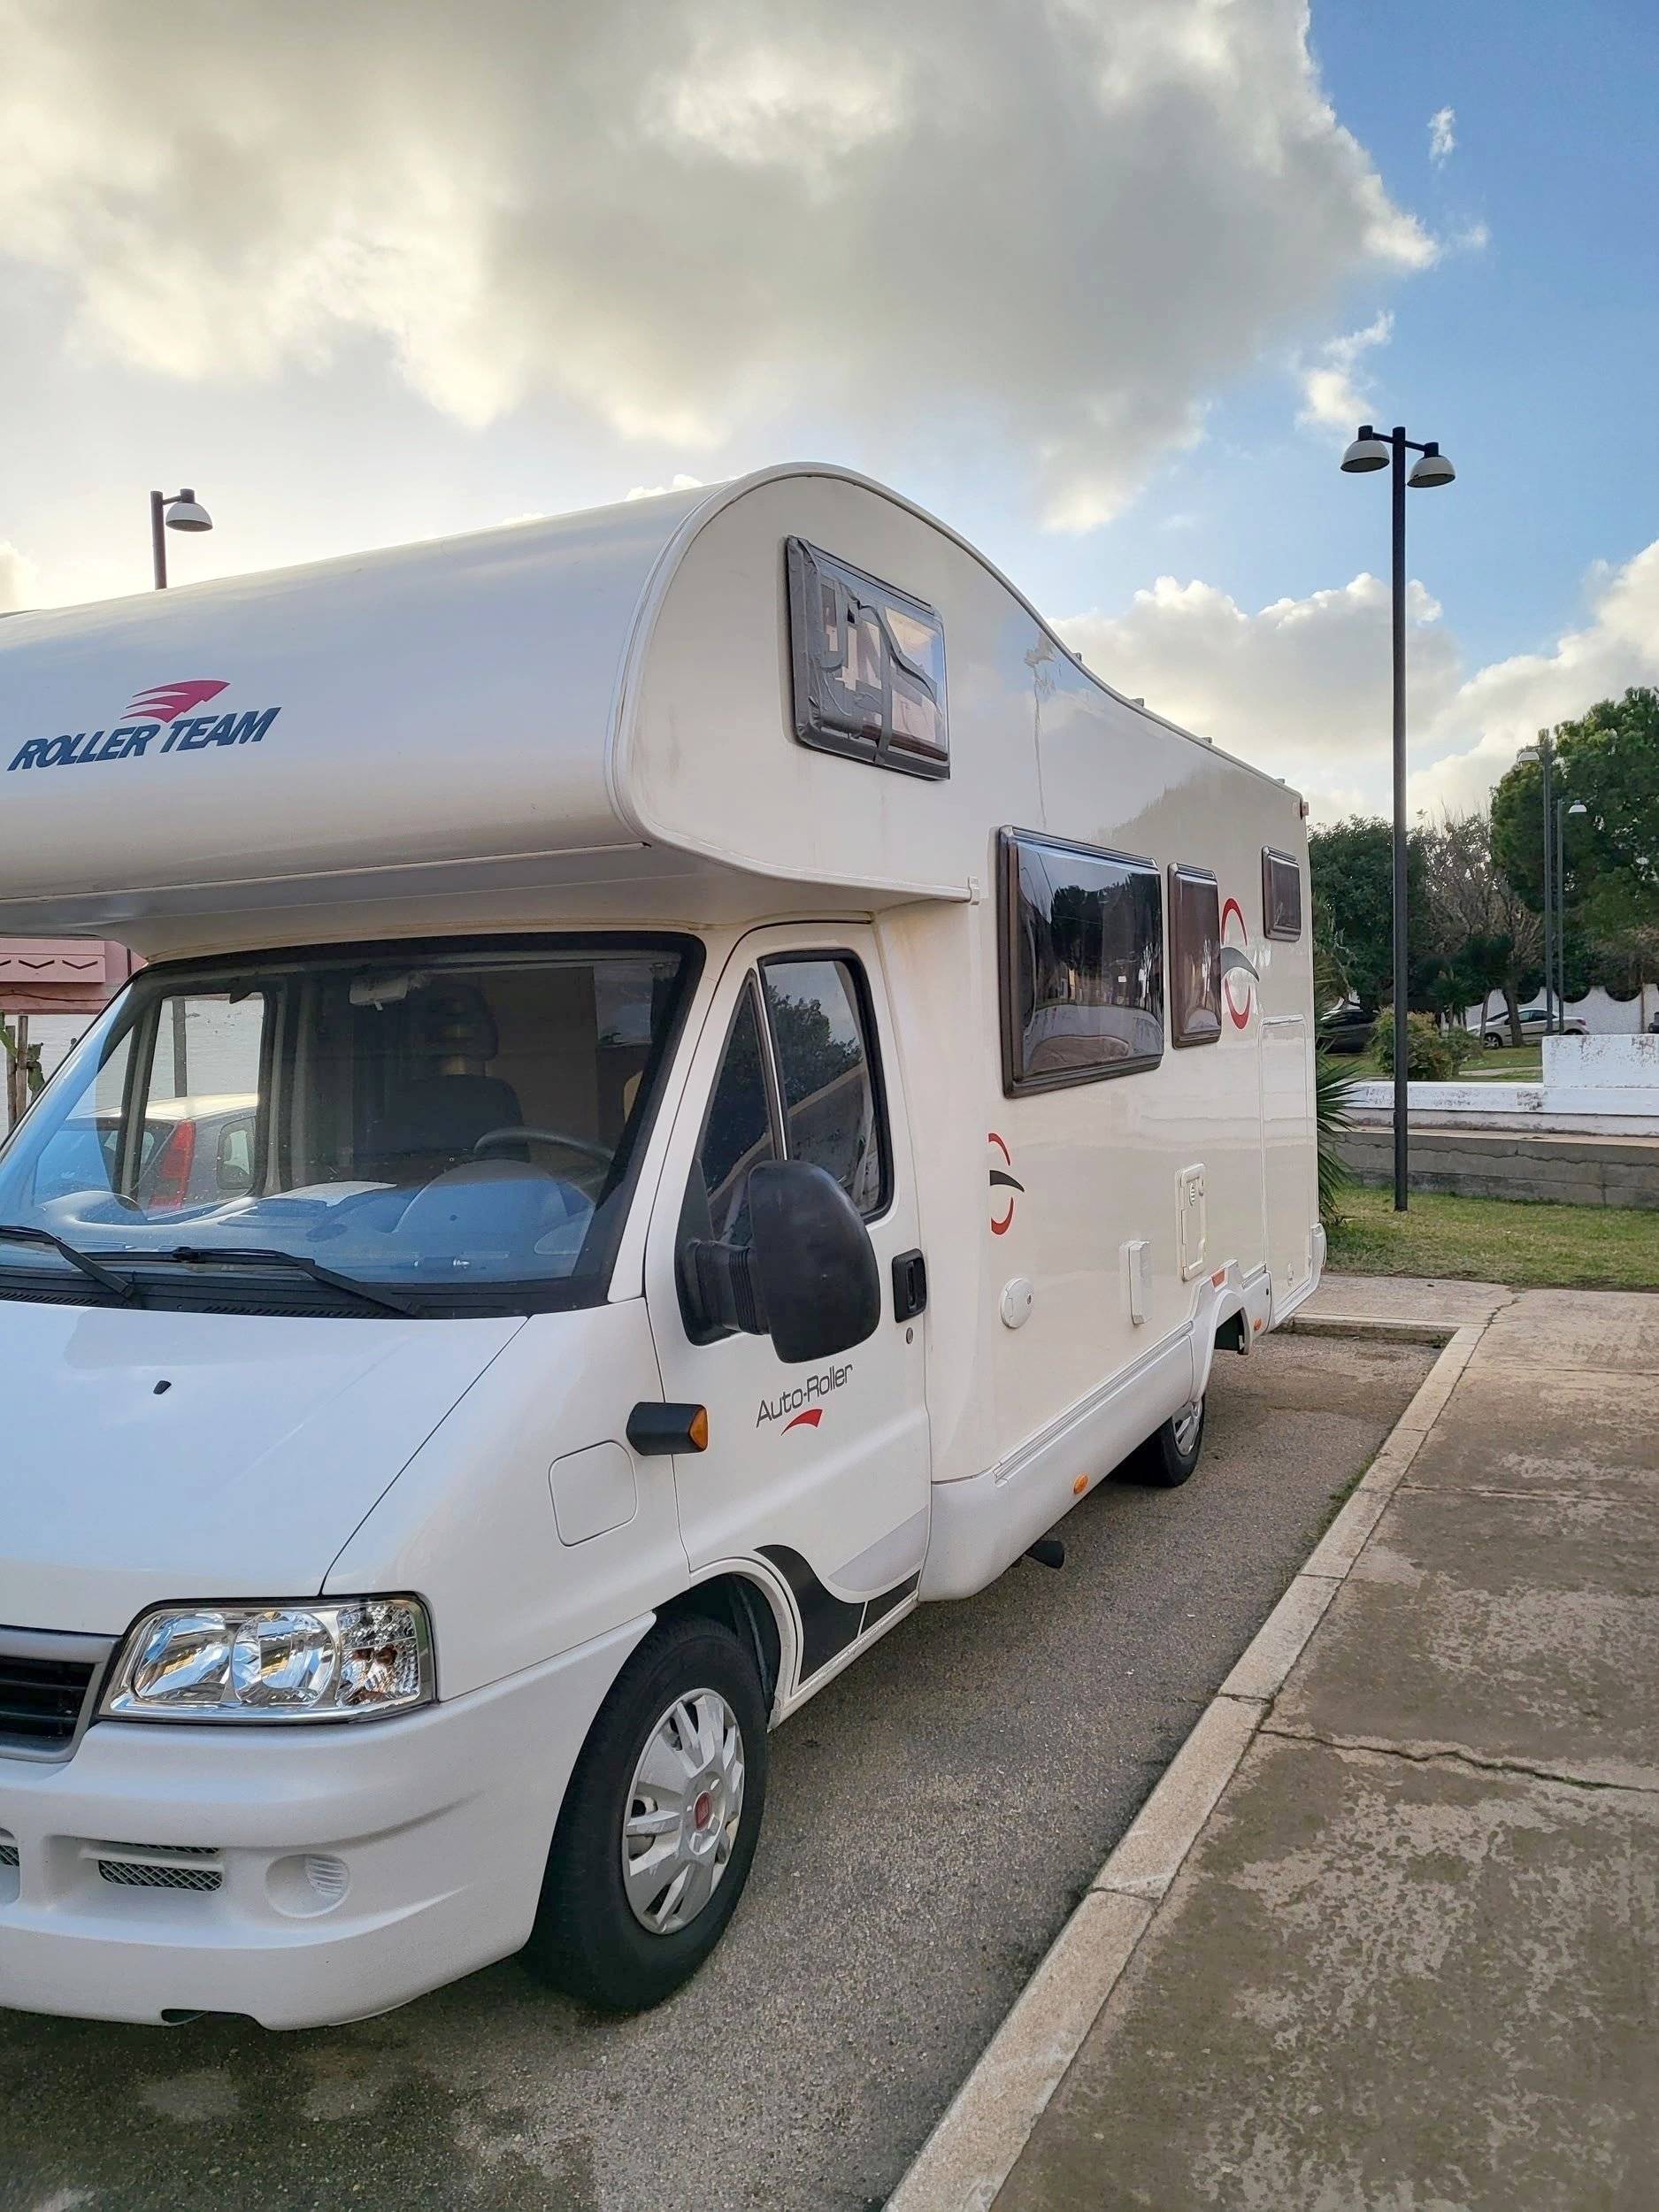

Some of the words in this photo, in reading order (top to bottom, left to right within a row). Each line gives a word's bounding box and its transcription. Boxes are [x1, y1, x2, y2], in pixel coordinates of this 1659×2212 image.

[7, 724, 161, 772] ROLLER
[159, 707, 282, 753] TEAM
[756, 1363, 853, 1428] Auto-Roller
